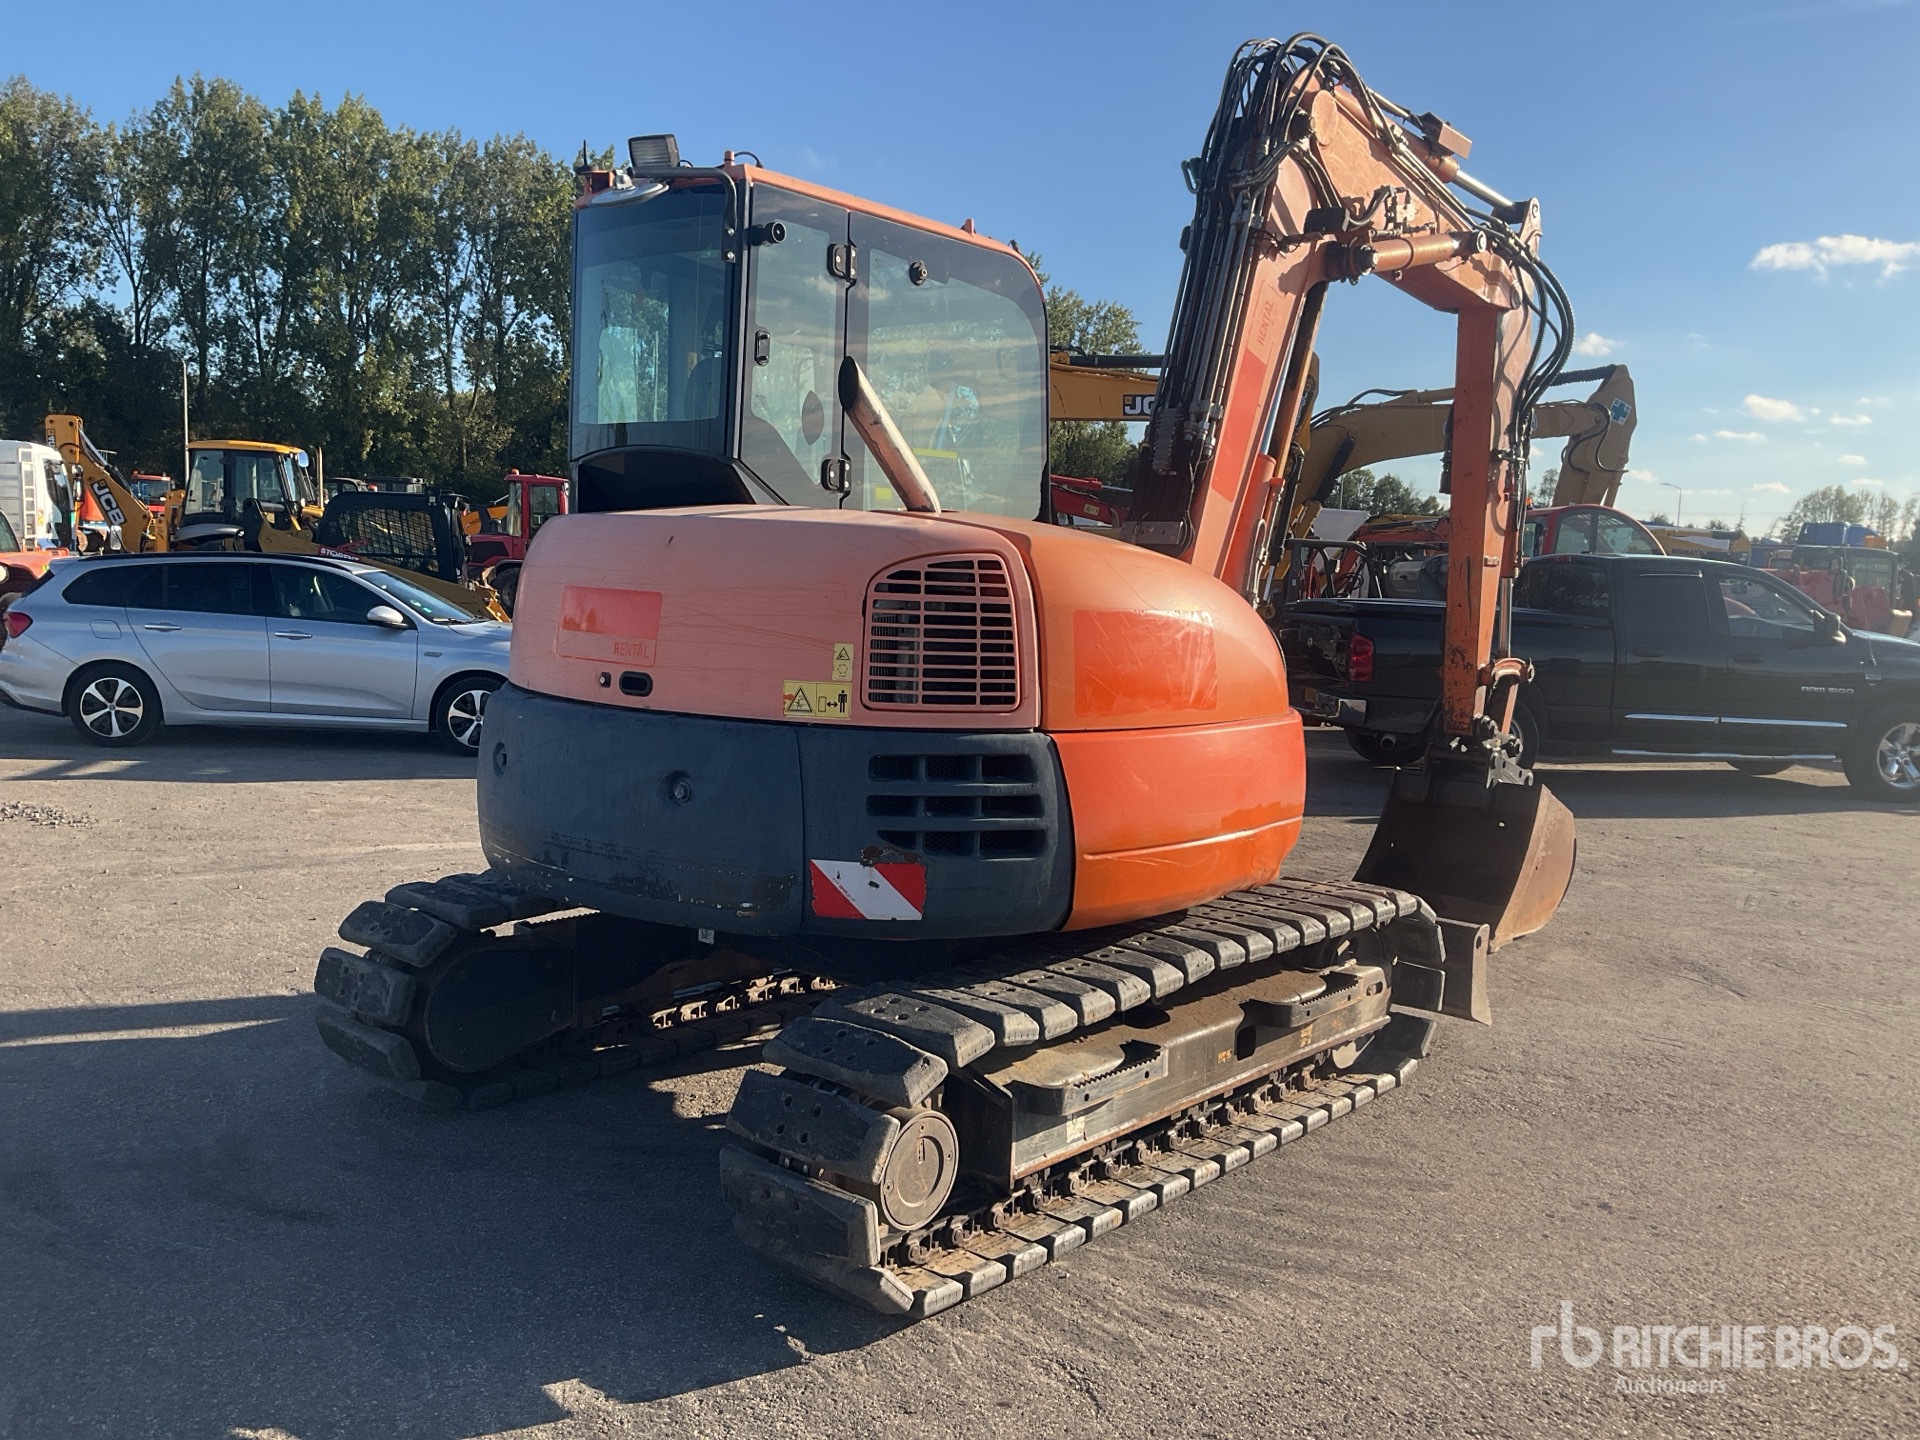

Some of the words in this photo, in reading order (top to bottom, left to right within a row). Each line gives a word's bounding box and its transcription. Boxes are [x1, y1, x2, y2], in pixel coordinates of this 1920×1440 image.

[1124, 396, 1156, 415] JC
[92, 481, 126, 526] JCB
[613, 641, 650, 659] RENTAL
